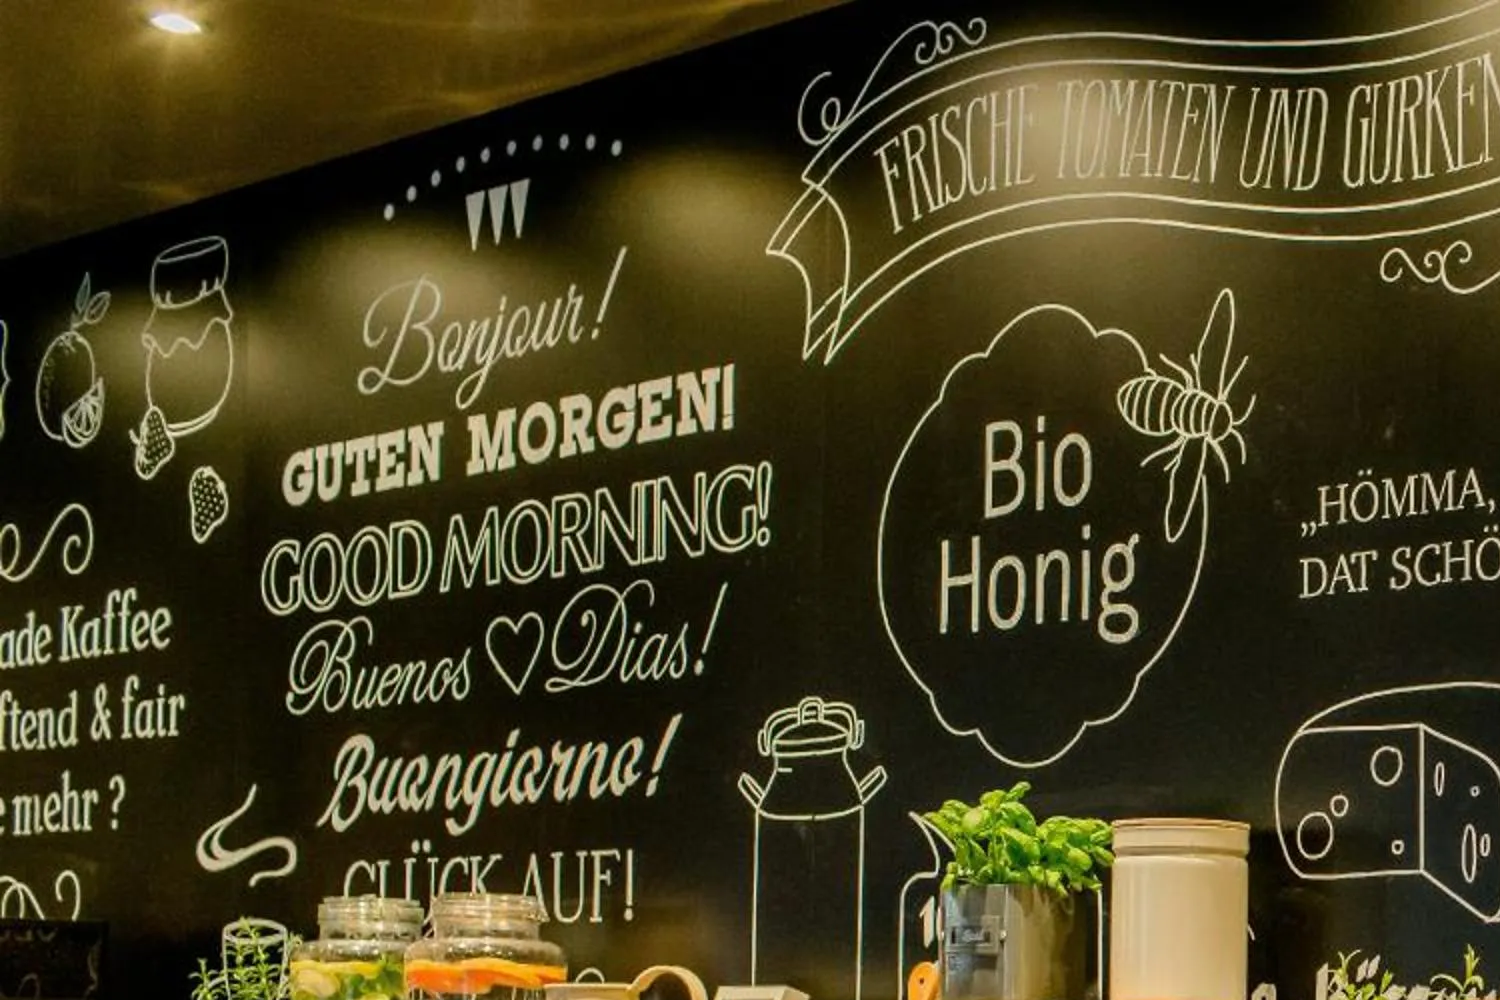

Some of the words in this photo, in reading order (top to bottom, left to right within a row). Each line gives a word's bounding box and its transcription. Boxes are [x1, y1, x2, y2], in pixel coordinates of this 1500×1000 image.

[873, 83, 1036, 235] FRISCHE
[1057, 79, 1237, 184] TOMATEN
[1238, 87, 1329, 191] UND
[282, 421, 444, 506] GUTEN
[466, 363, 735, 476] MORGEN!
[985, 414, 1092, 518] Bio
[261, 520, 432, 616] GOOD
[439, 461, 772, 593] MORNING!
[938, 525, 1140, 644] Honig
[1299, 550, 1378, 599] DAT
[58, 587, 173, 662] Kaffee
[285, 616, 471, 716] Buenos
[545, 579, 728, 693] Dias!
[91, 682, 112, 741] &
[121, 674, 186, 739] fair
[12, 769, 99, 836] mehr
[317, 713, 683, 836] Buongiorno!
[523, 848, 634, 923] AUF!
